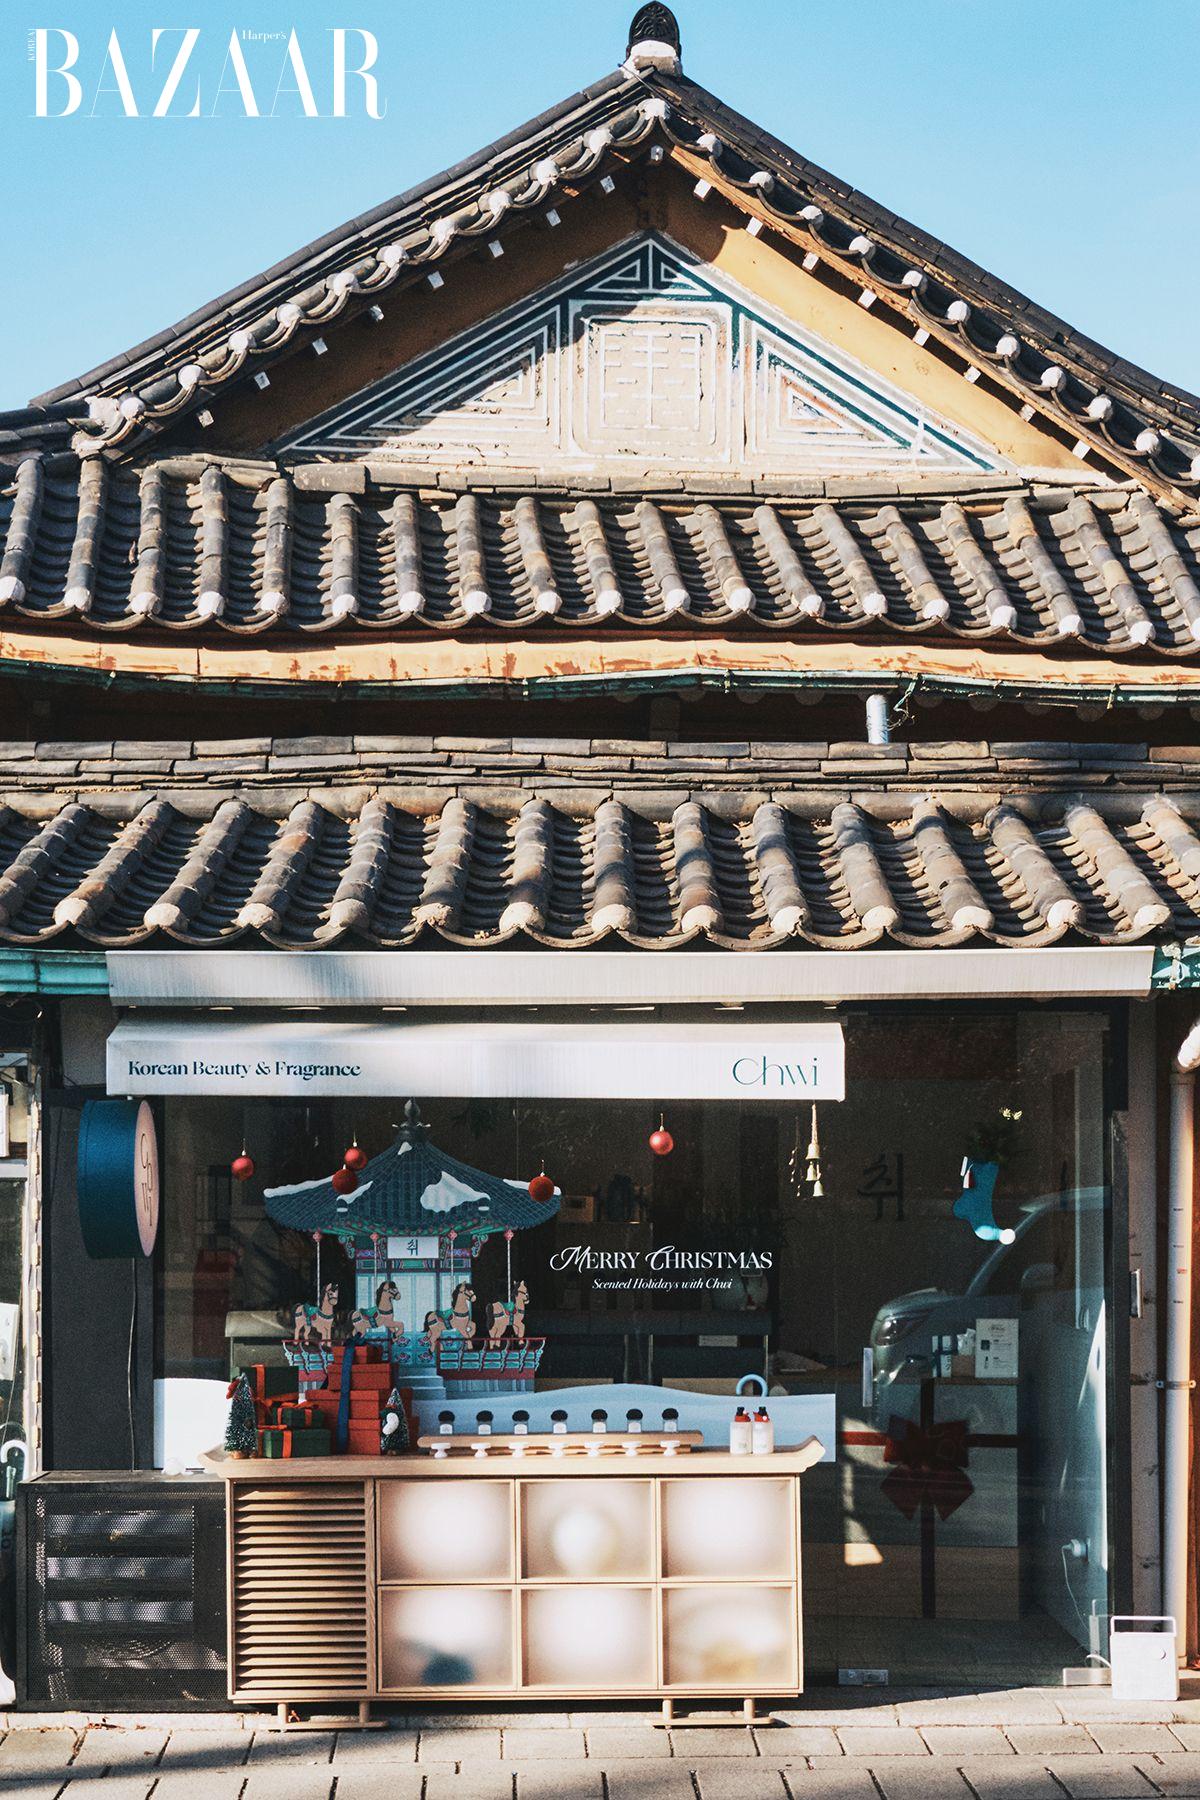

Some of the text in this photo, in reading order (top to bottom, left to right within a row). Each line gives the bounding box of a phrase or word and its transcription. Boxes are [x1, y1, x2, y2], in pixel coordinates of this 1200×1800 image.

[128, 1060, 361, 1081] Korean Beauty & Fragrance
[732, 1055, 818, 1086] Chwi
[857, 1151, 905, 1222] 취
[549, 1245, 773, 1273] MERRY CHRISTMAS
[591, 1277, 631, 1290] Scented
[632, 1277, 679, 1292] Holidays
[680, 1278, 704, 1290] with
